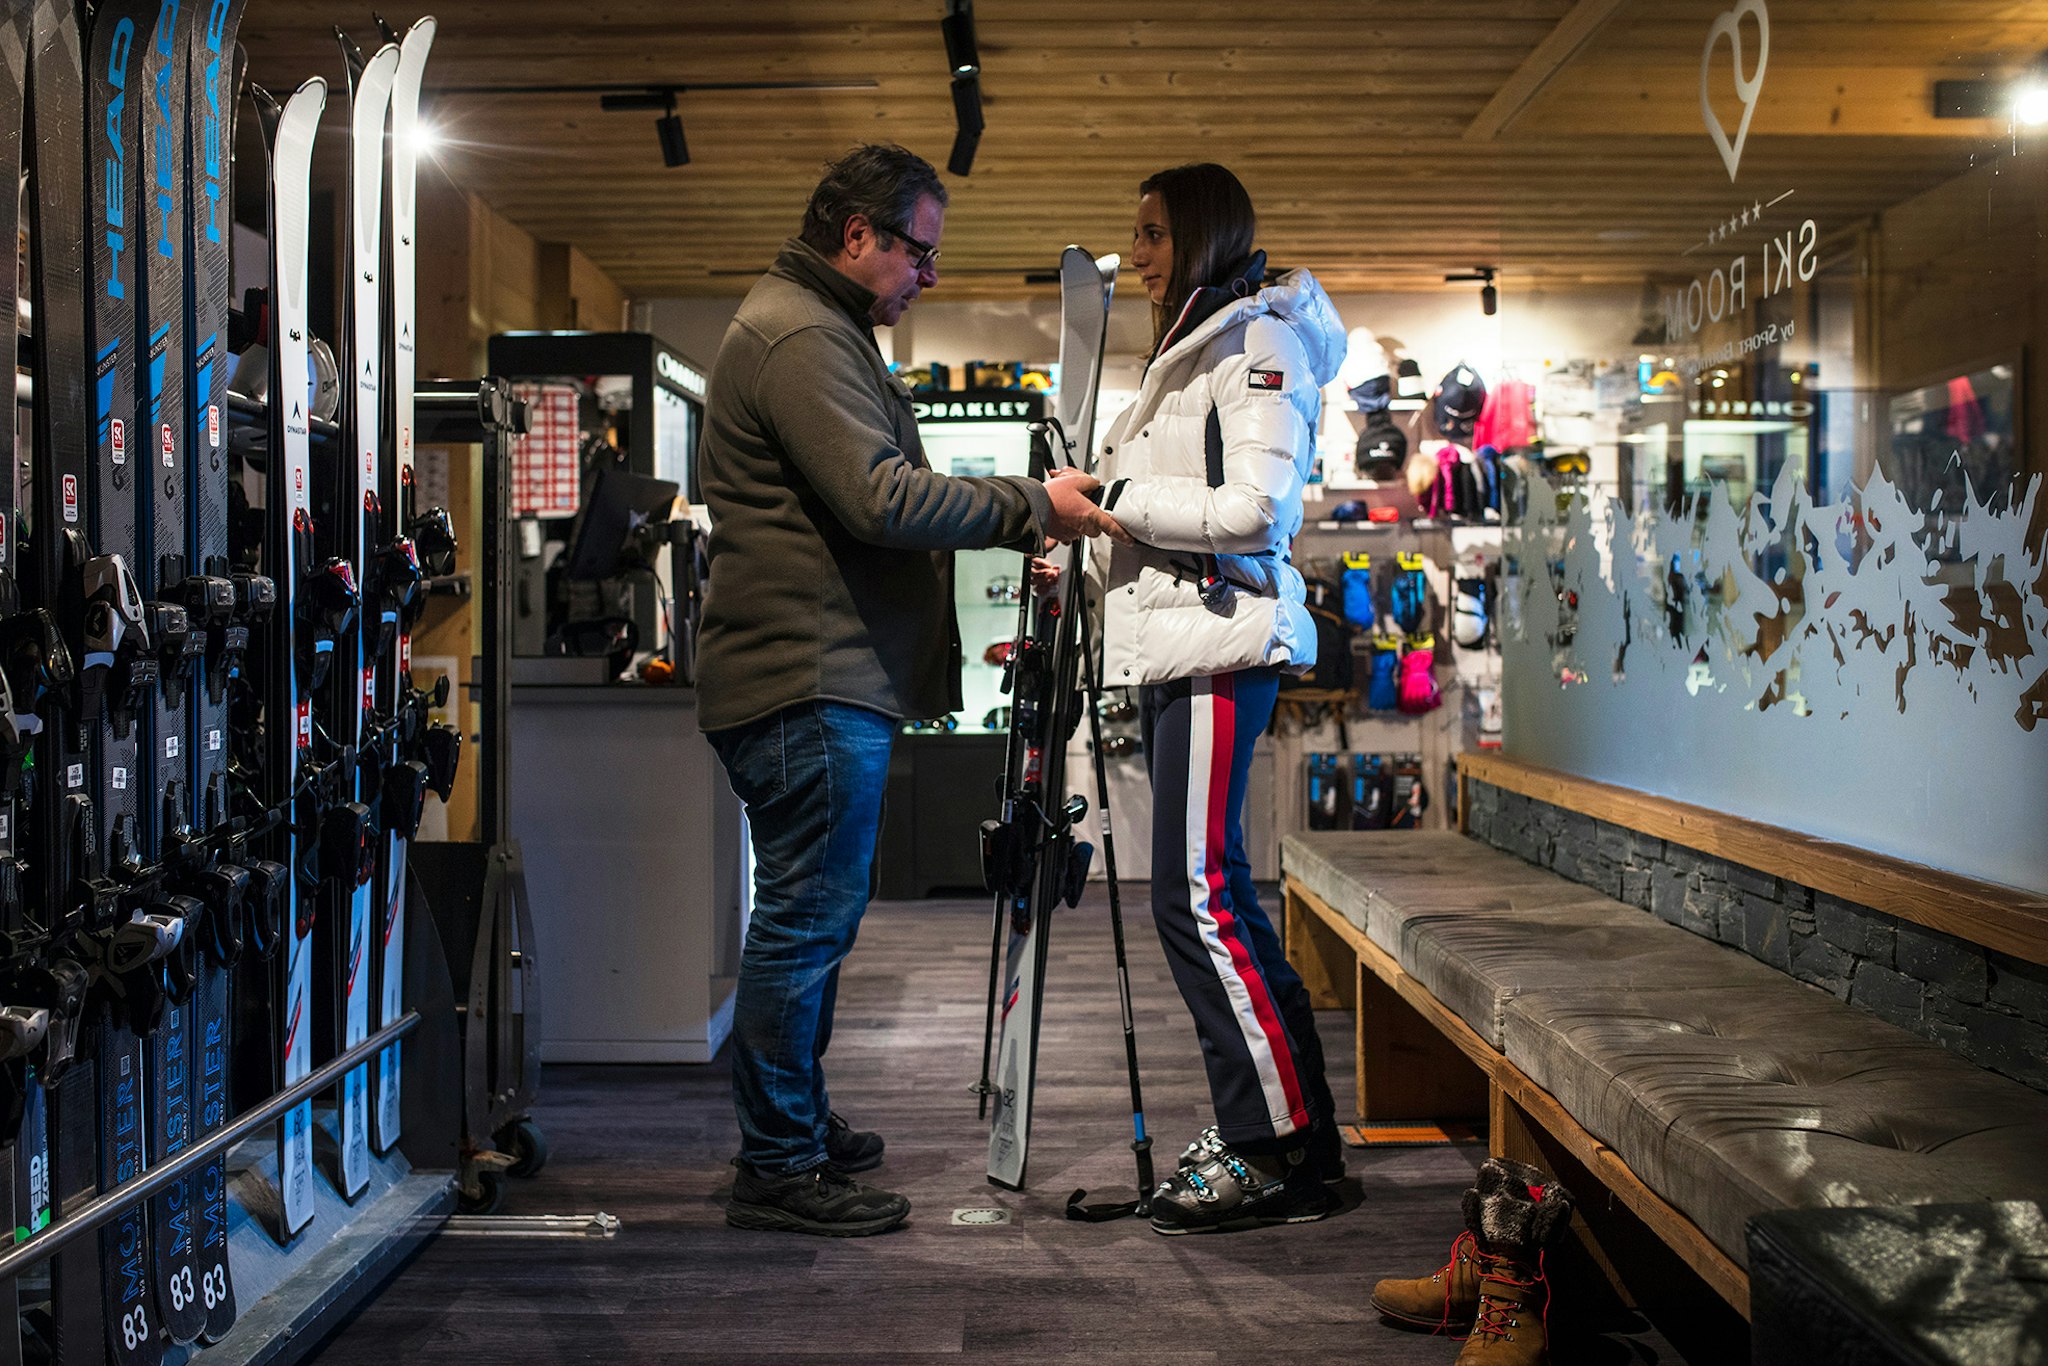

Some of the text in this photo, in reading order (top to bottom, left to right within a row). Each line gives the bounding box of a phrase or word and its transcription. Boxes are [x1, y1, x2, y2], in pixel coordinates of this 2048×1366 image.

[106, 16, 135, 300] HEAD
[157, 0, 181, 259] HEAD
[205, 0, 231, 244] HEAD
[930, 401, 1030, 417] OAKLEY
[116, 1077, 140, 1304] MOSTER
[203, 1018, 222, 1248] MOSTER
[121, 1303, 149, 1351] 83
[169, 1265, 195, 1312] 83
[201, 1263, 227, 1310] 83
